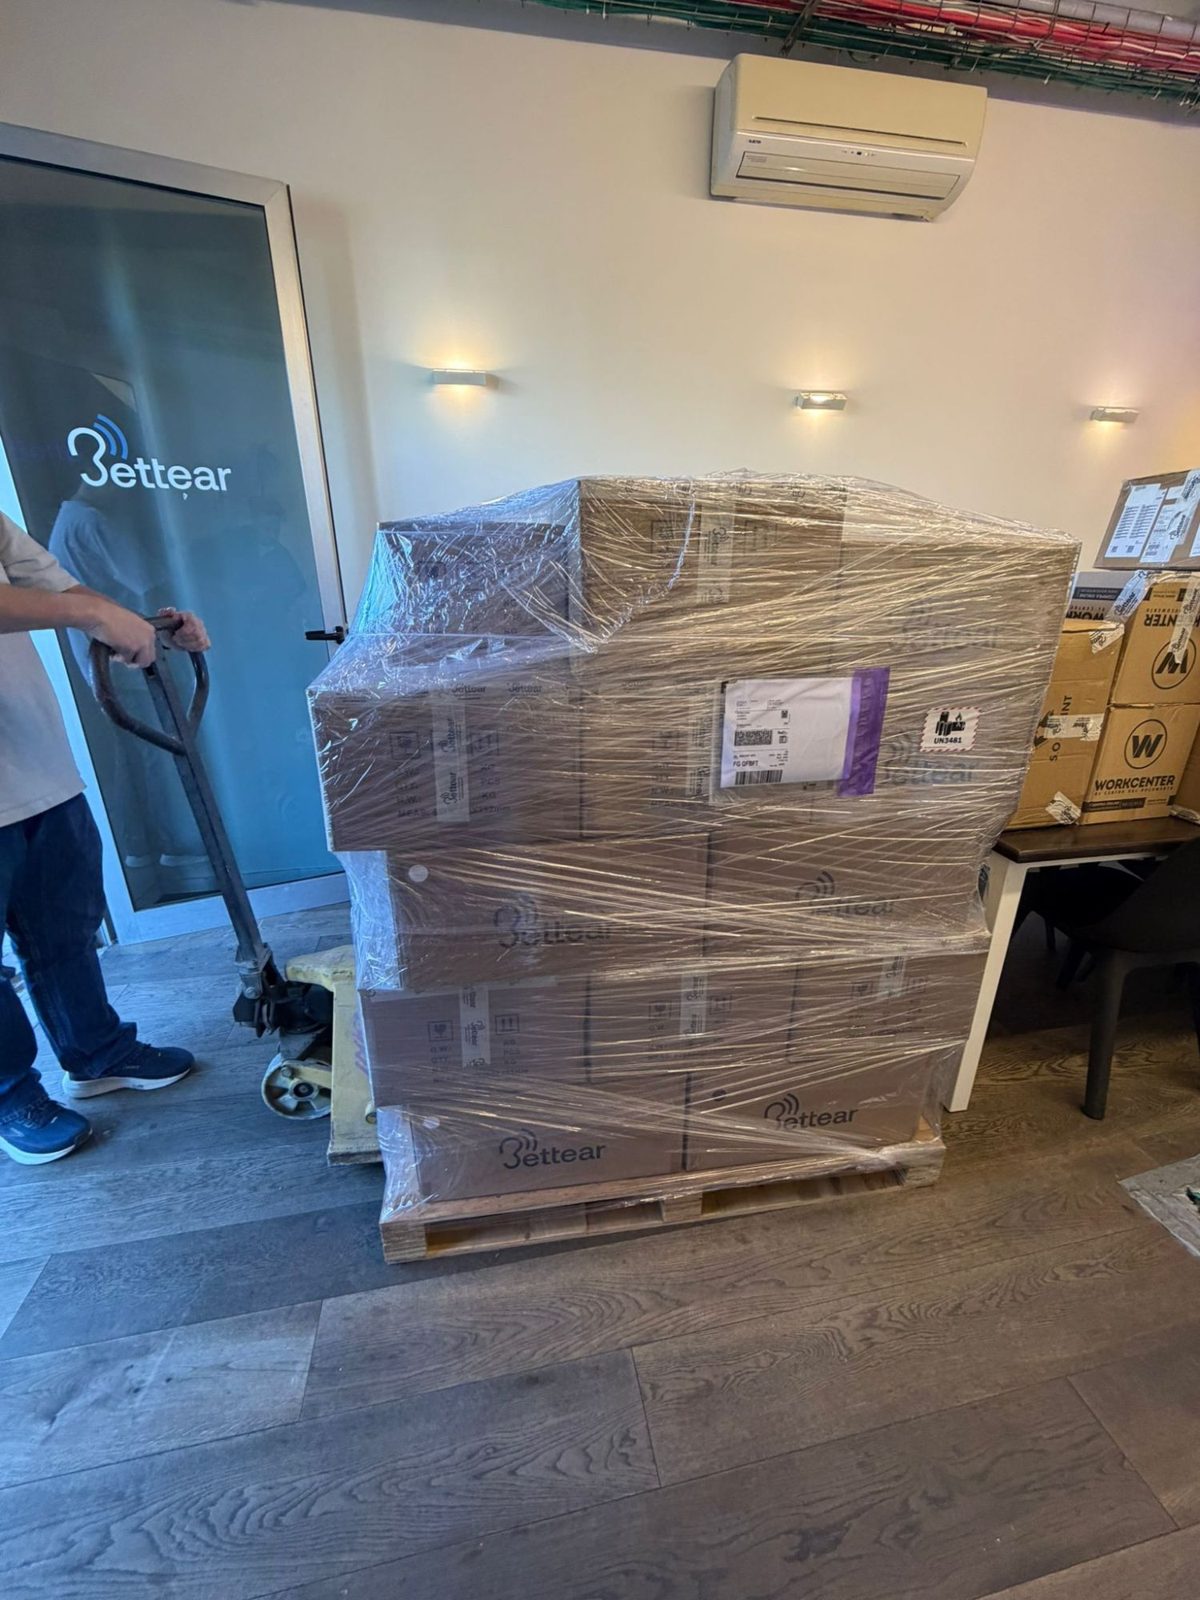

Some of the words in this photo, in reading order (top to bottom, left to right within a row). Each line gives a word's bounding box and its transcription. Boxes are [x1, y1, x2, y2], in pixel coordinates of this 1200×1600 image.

[67, 426, 232, 492] Bettear
[933, 737, 962, 745] UN3481
[1132, 734, 1164, 758] W
[1094, 775, 1176, 791] WORKCENTER
[499, 1136, 606, 1169] Bettear
